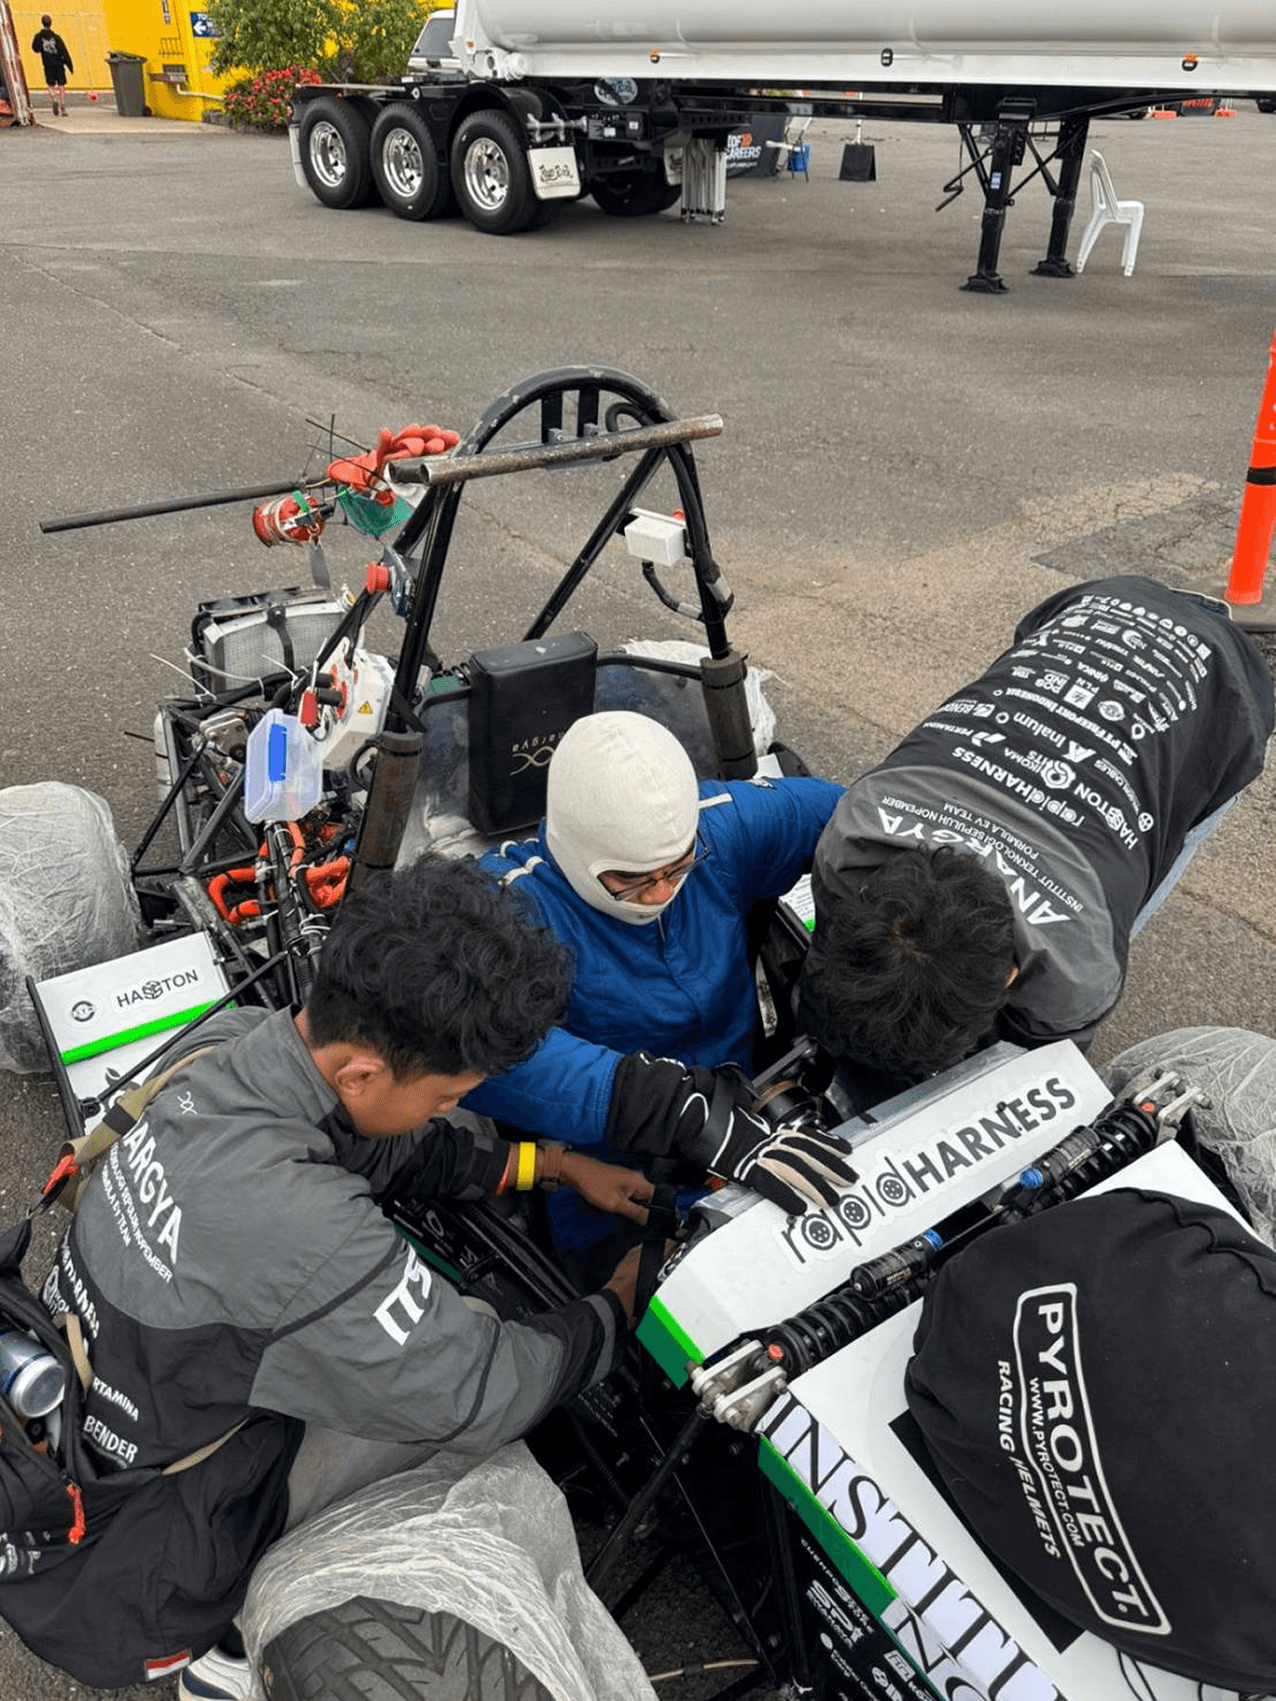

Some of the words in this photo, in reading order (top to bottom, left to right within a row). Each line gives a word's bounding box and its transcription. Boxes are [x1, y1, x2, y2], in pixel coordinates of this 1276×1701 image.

[1035, 679, 1063, 694] POS
[1076, 677, 1099, 694] PLN
[1077, 662, 1104, 681] INKA
[935, 704, 974, 714] BEND
[1006, 688, 1058, 712] INDONESIA
[1013, 712, 1066, 748] Inalum
[1055, 706, 1106, 739] FREEPORT
[1103, 733, 1121, 749] PT
[1004, 748, 1042, 773] IKOMA
[1027, 751, 1048, 768] ITS
[1095, 760, 1126, 786] CABLES
[952, 747, 1084, 827] rapidHARNESS
[882, 797, 938, 820] NOPEMBER
[944, 803, 971, 821] TEAM
[975, 818, 990, 828] EV
[939, 815, 985, 840] SEPULUH
[992, 825, 1039, 859] FORMULA
[878, 807, 1070, 924] ANARGYA
[984, 836, 1038, 877] TEKNOLOGI
[1039, 876, 1083, 912] INSTITUT
[781, 1078, 1077, 1264] rapidHARNESS
[123, 1121, 183, 1265] ARGYA
[117, 1215, 131, 1246] TEAM
[121, 1187, 139, 1231] SEPULUH
[134, 1230, 172, 1283] NOPEMBER
[93, 1377, 138, 1421] RTAMINA
[84, 1416, 138, 1463] BENDER
[998, 1360, 1016, 1452] RACING
[1009, 1456, 1061, 1558] HELMETS
[1029, 1377, 1086, 1547] WWW.PYROTECT.COM
